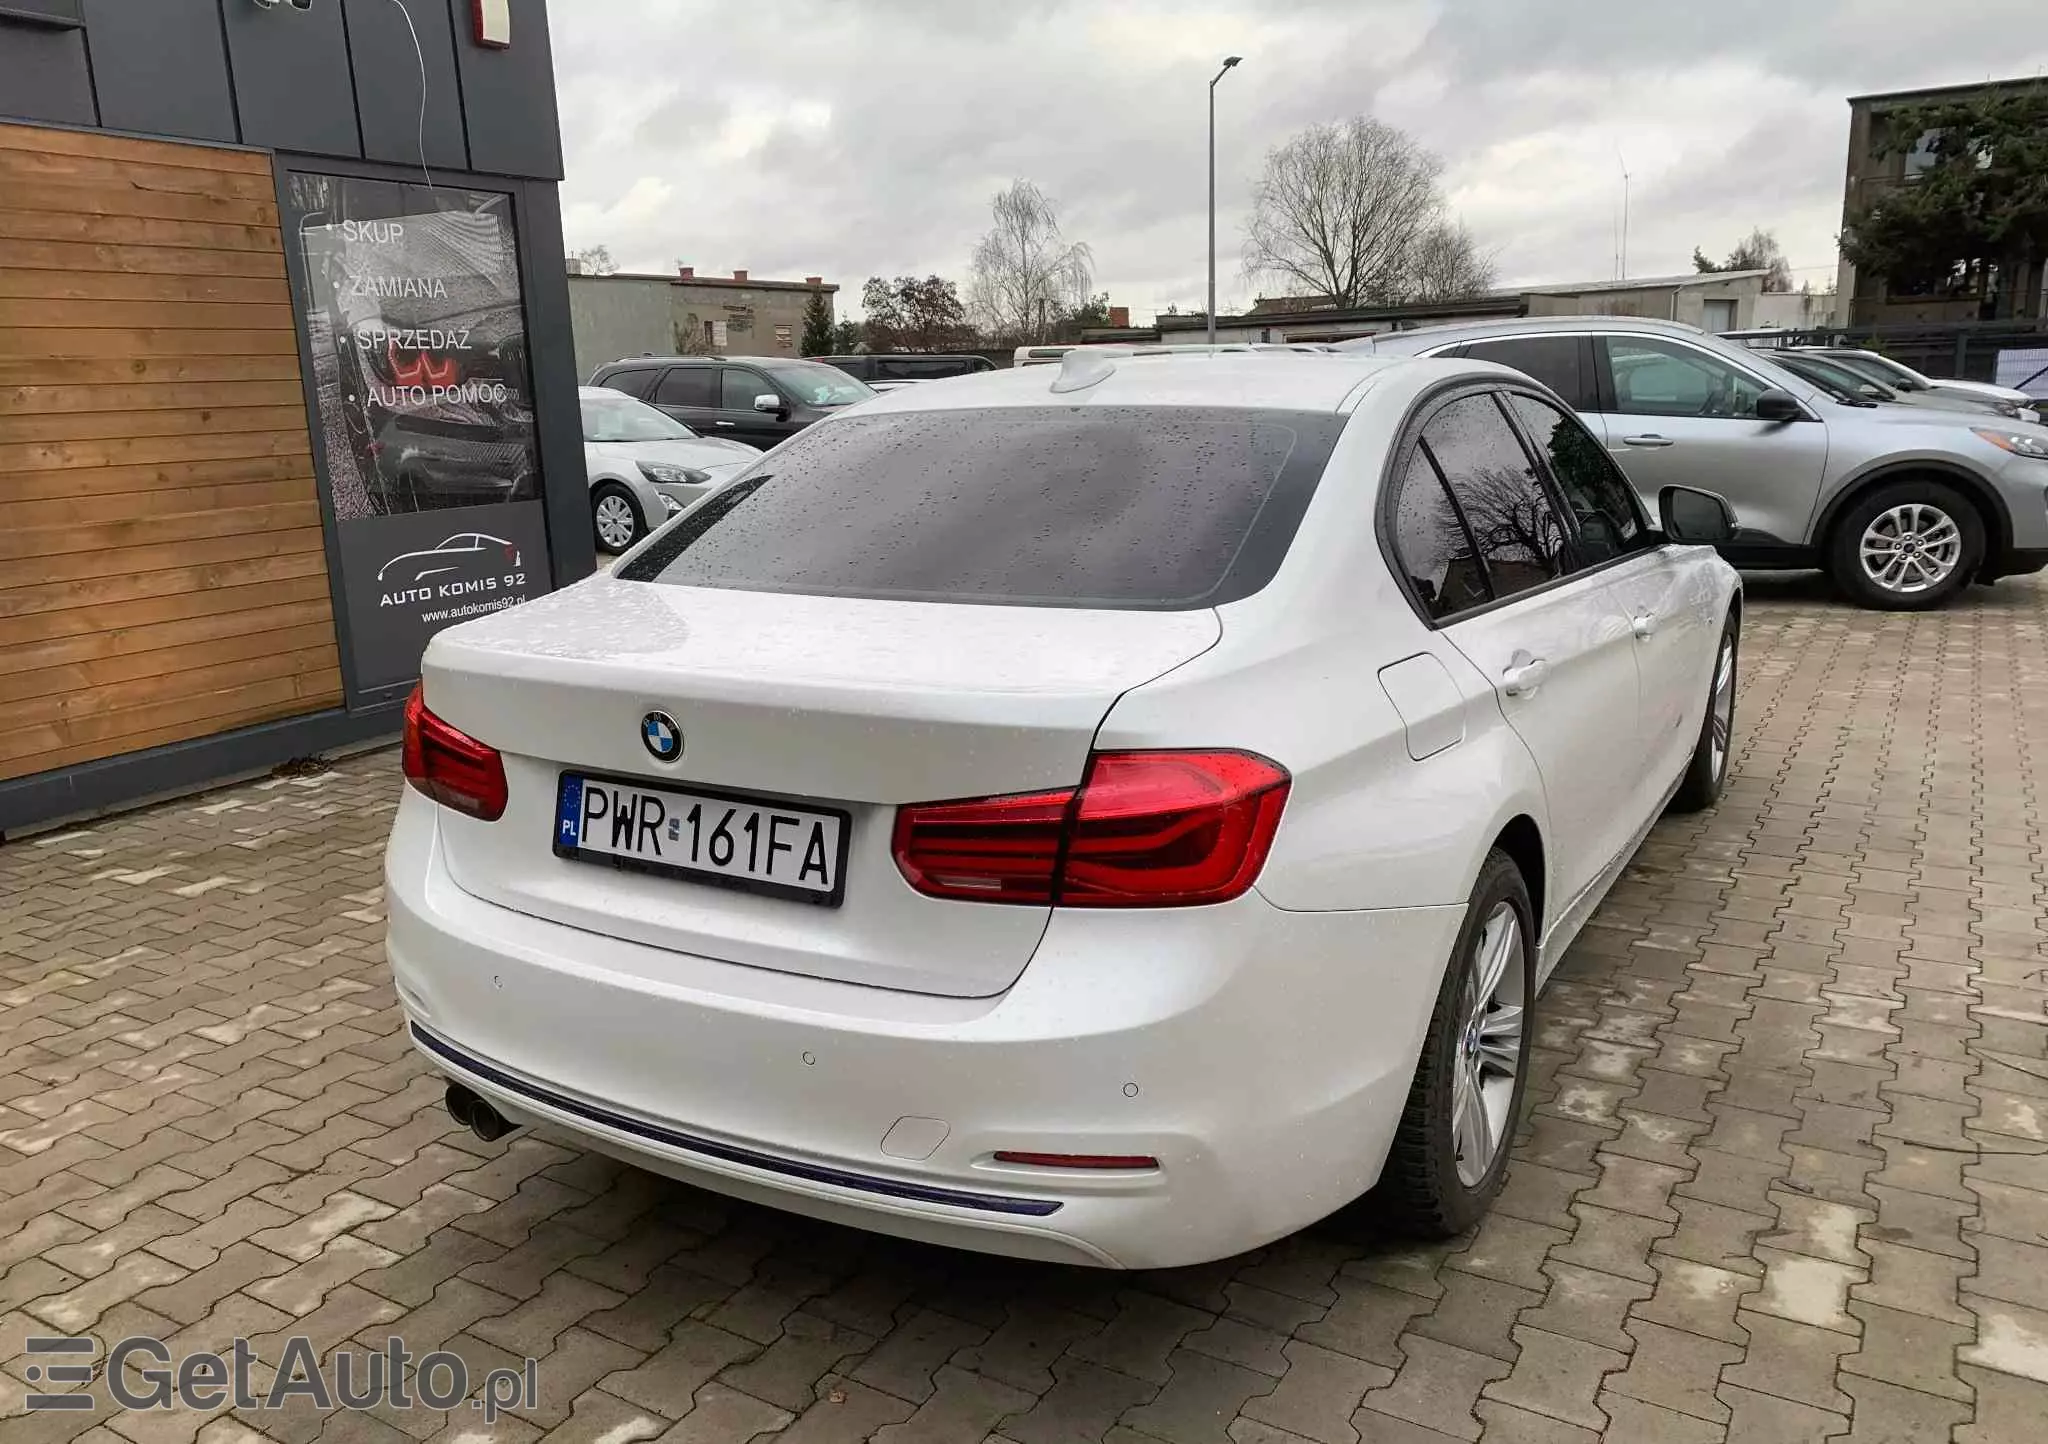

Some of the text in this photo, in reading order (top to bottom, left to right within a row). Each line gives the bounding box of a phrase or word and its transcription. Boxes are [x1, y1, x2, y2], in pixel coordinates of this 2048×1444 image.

[343, 219, 404, 243] SKUP
[349, 275, 448, 299] ZAMIANA
[367, 383, 507, 407] AUTO POMOC
[380, 573, 526, 607] AUTO KOMIS 92
[421, 594, 526, 623] www.autokomis92.pl
[562, 819, 577, 836] PL
[582, 786, 828, 885] PWR 161FA
